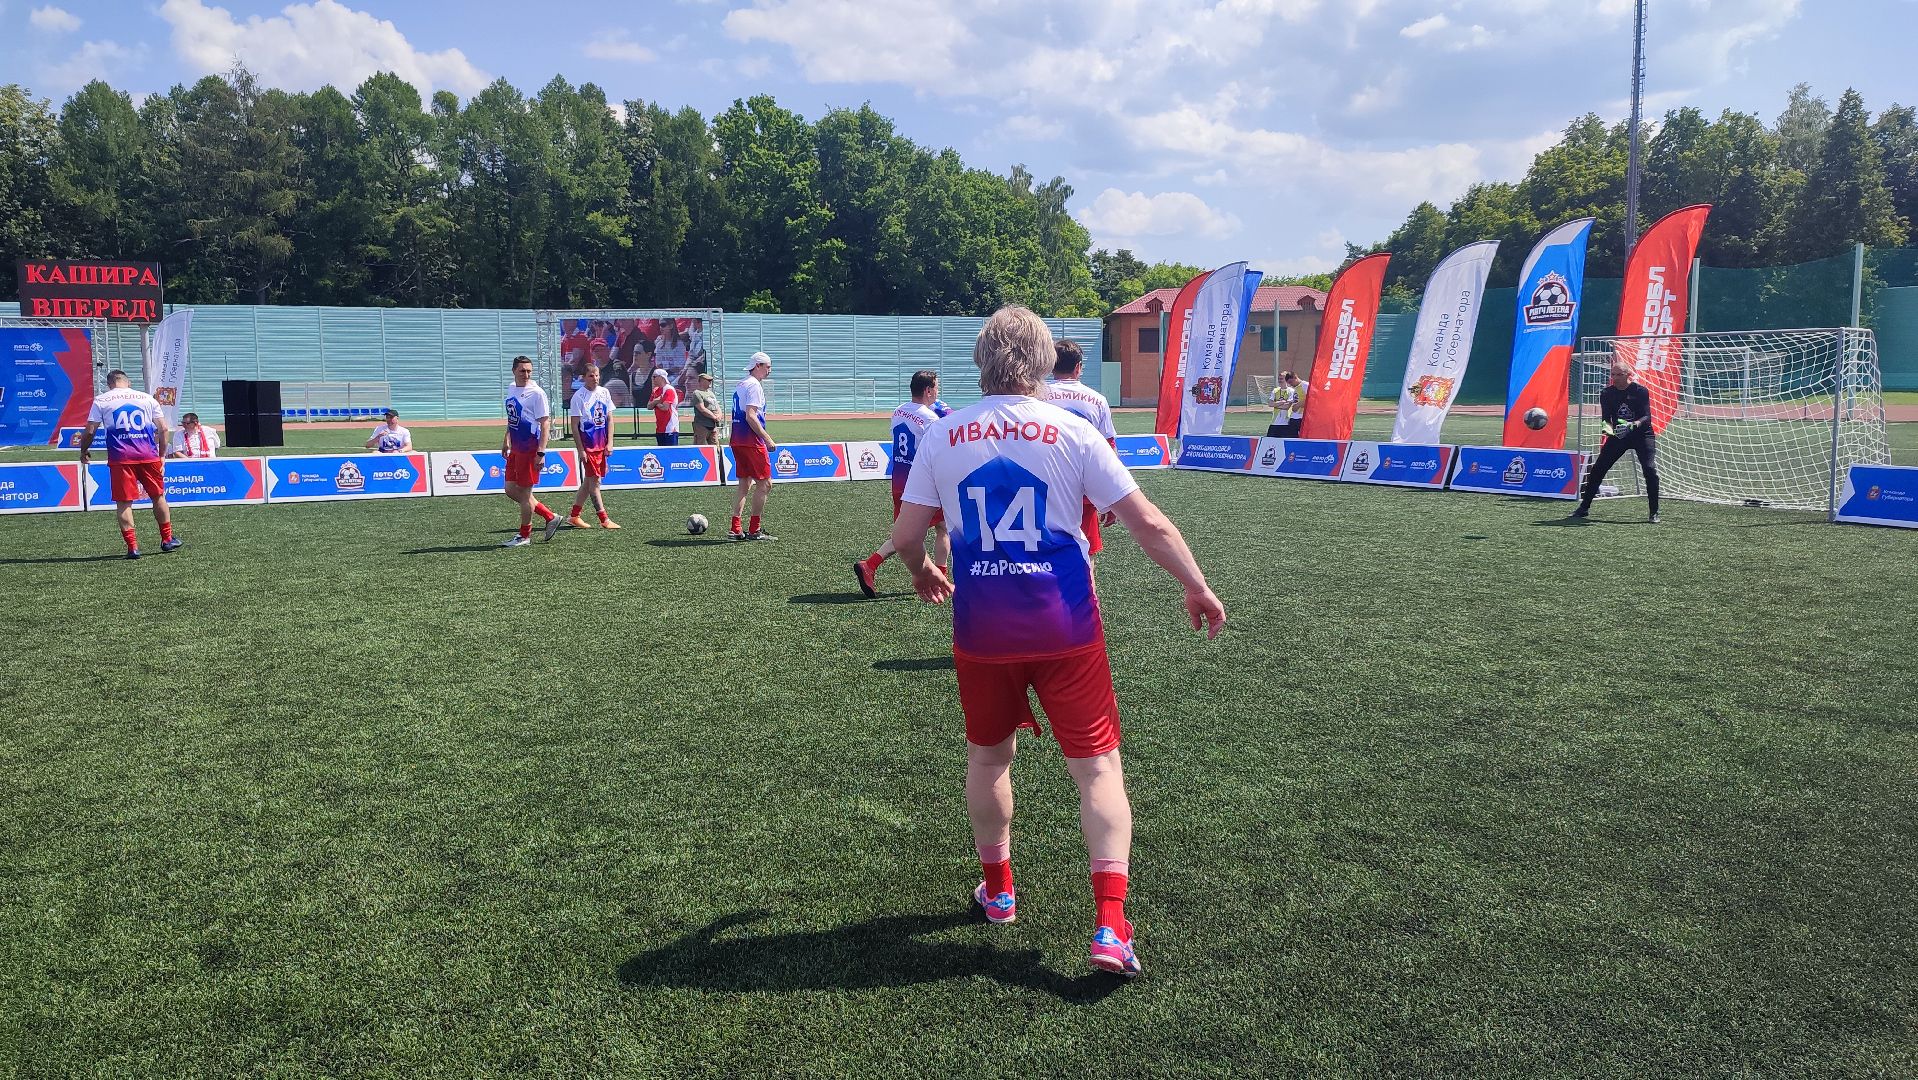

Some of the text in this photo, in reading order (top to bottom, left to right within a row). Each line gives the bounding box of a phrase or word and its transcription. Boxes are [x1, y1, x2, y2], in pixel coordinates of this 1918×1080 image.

[25, 264, 159, 286] КАШИРА
[31, 298, 156, 322] ВПЕРЕД!
[1202, 324, 1216, 369] Команда
[1214, 303, 1231, 370] Губернатора
[1327, 299, 1355, 378] МОСОБЛ
[1340, 316, 1364, 380] СПОРТ
[1427, 313, 1450, 367] Команда
[1442, 290, 1471, 370] Губернатора
[116, 410, 146, 431] 40
[949, 421, 1059, 448] ИВАНОВ
[899, 432, 909, 456] 8
[163, 475, 204, 483] оманда
[164, 485, 227, 496] убернатора
[967, 486, 1043, 552] 14
